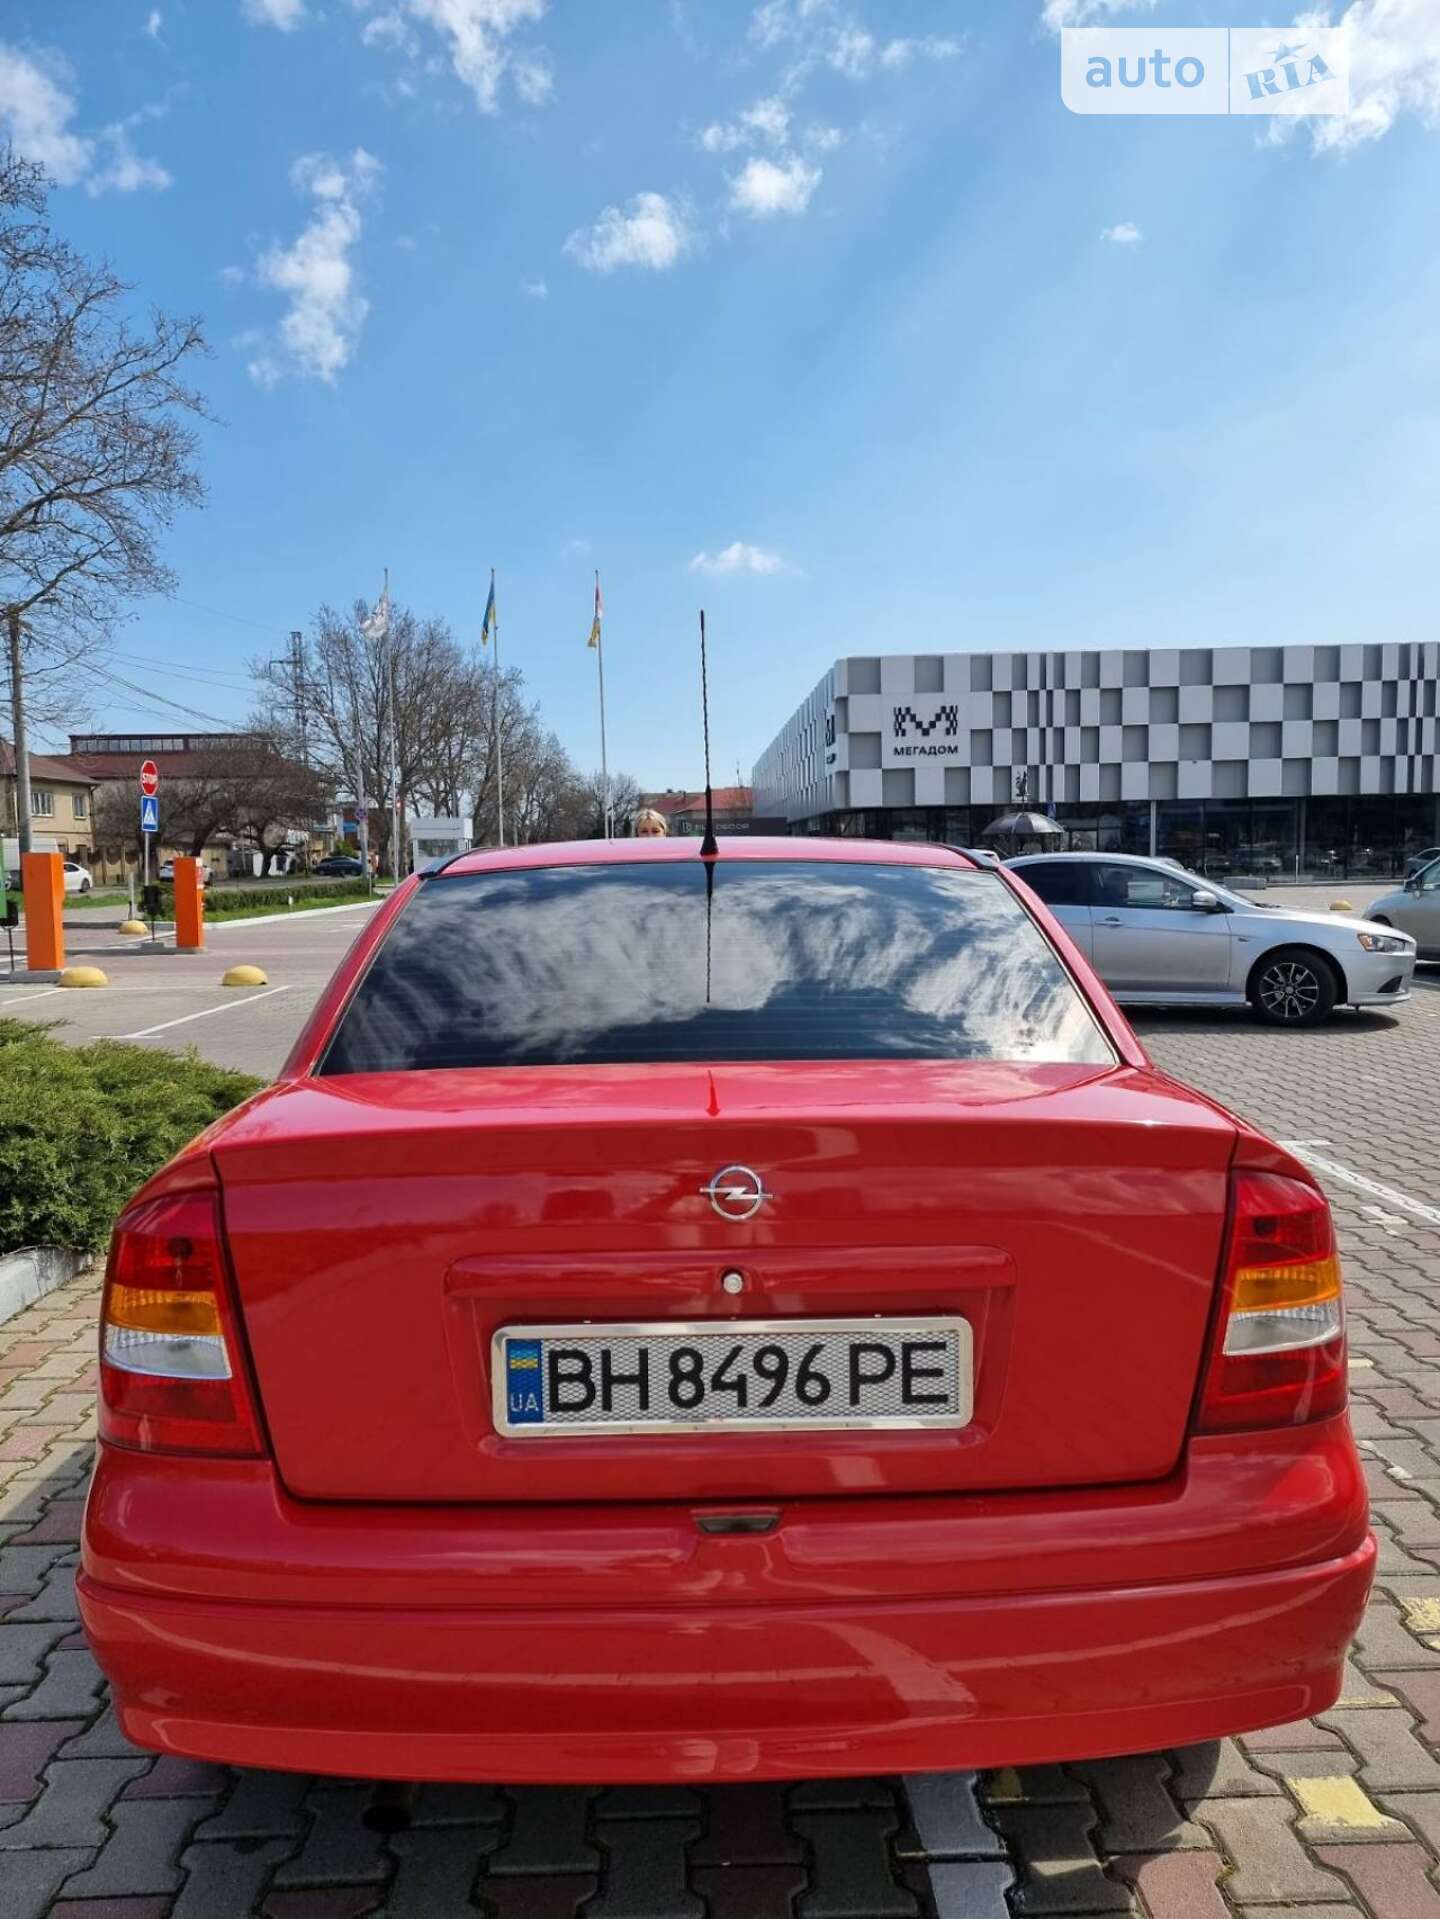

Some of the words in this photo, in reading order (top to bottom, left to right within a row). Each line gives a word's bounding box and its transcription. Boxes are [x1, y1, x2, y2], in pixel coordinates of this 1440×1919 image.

[893, 745, 959, 757] МЕГАДОМ
[142, 773, 158, 785] STOP
[548, 1347, 650, 1413] BH
[667, 1344, 832, 1409] 8496
[848, 1341, 949, 1406] PE
[509, 1392, 540, 1412] UA
